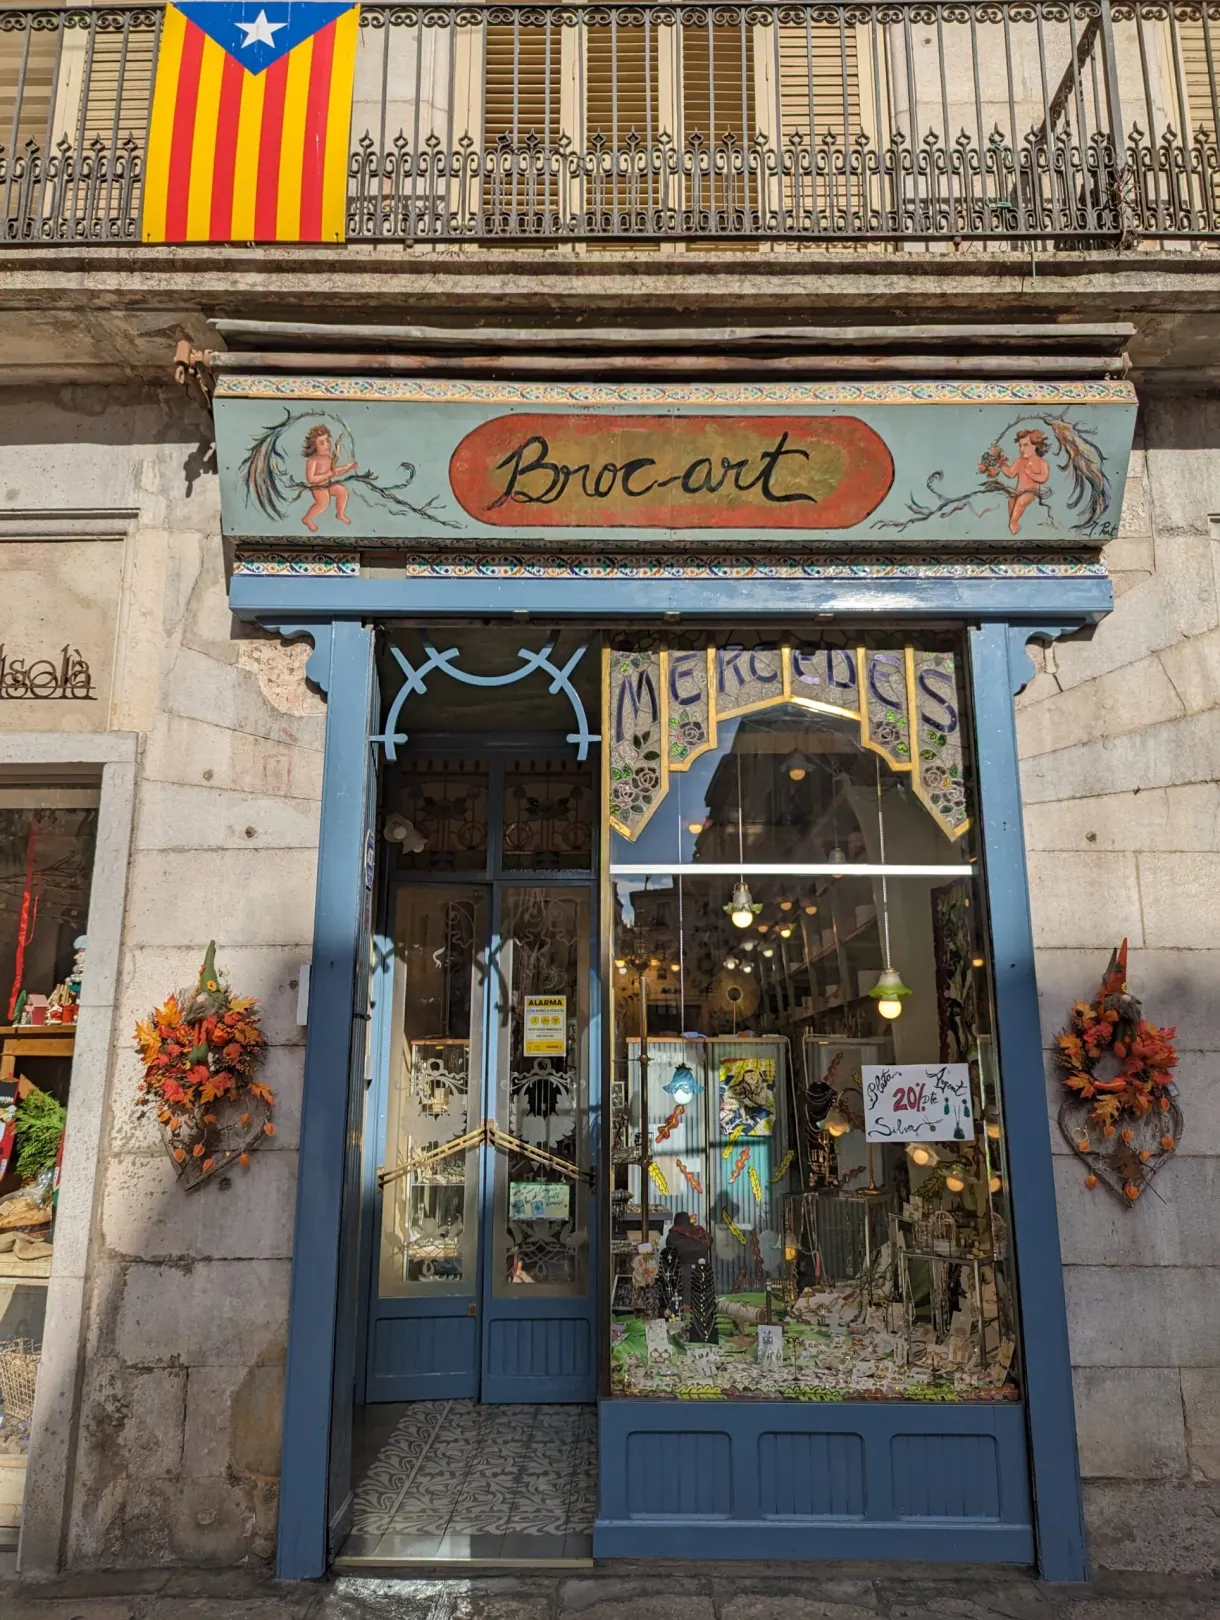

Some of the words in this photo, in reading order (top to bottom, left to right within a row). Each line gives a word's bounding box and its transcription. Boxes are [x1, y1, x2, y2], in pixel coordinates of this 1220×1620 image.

[486, 431, 818, 511] Broc-art
[616, 643, 958, 743] MERCEDES
[892, 1082, 926, 1112] 20%
